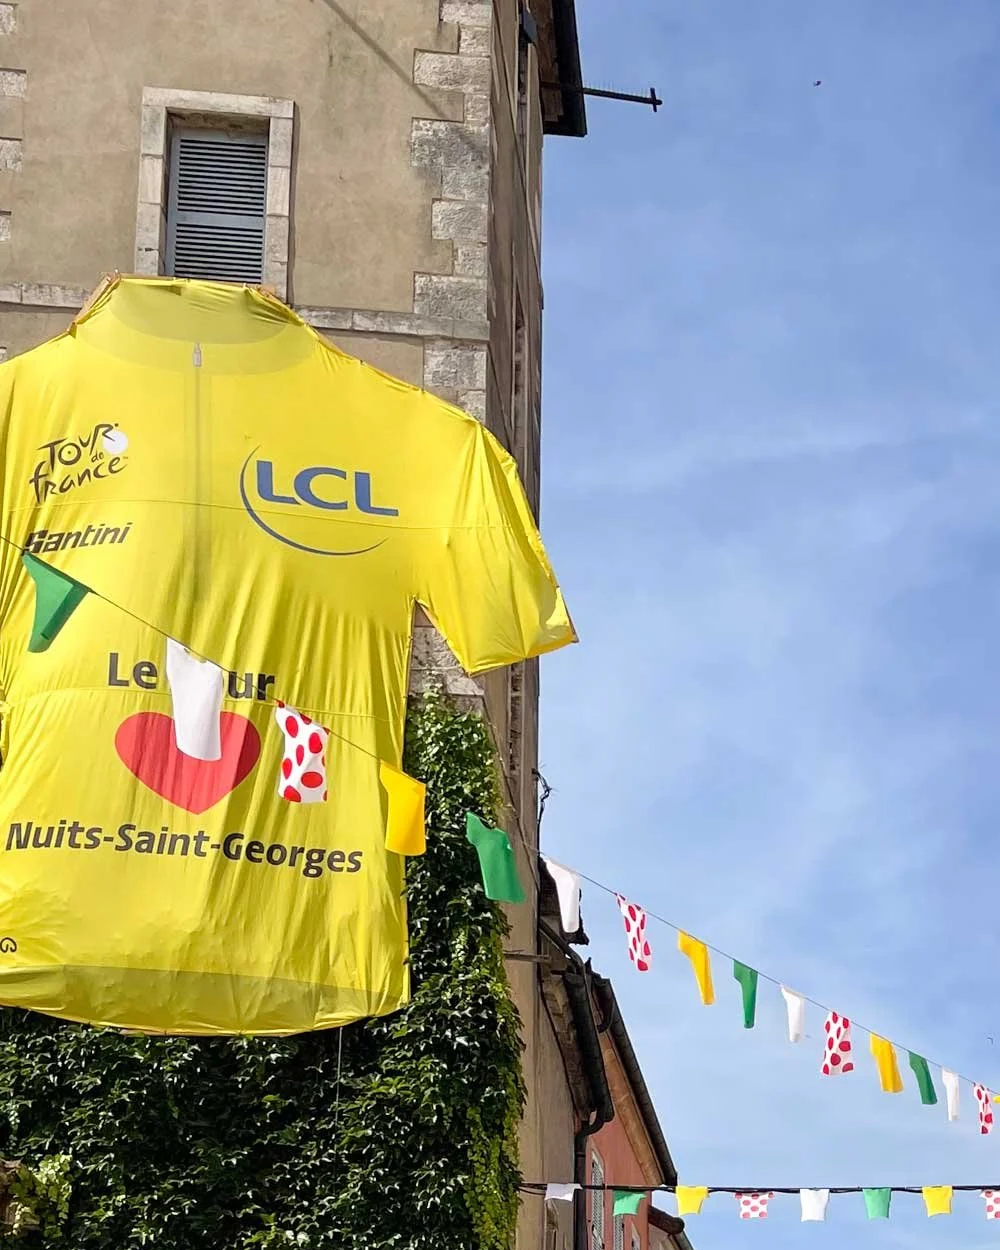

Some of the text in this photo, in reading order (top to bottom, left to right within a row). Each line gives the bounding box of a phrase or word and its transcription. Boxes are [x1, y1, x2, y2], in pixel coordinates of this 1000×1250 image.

[257, 460, 399, 517] LCL
[108, 652, 158, 690] Le
[6, 820, 363, 878] Nuits-Saint-Georges
